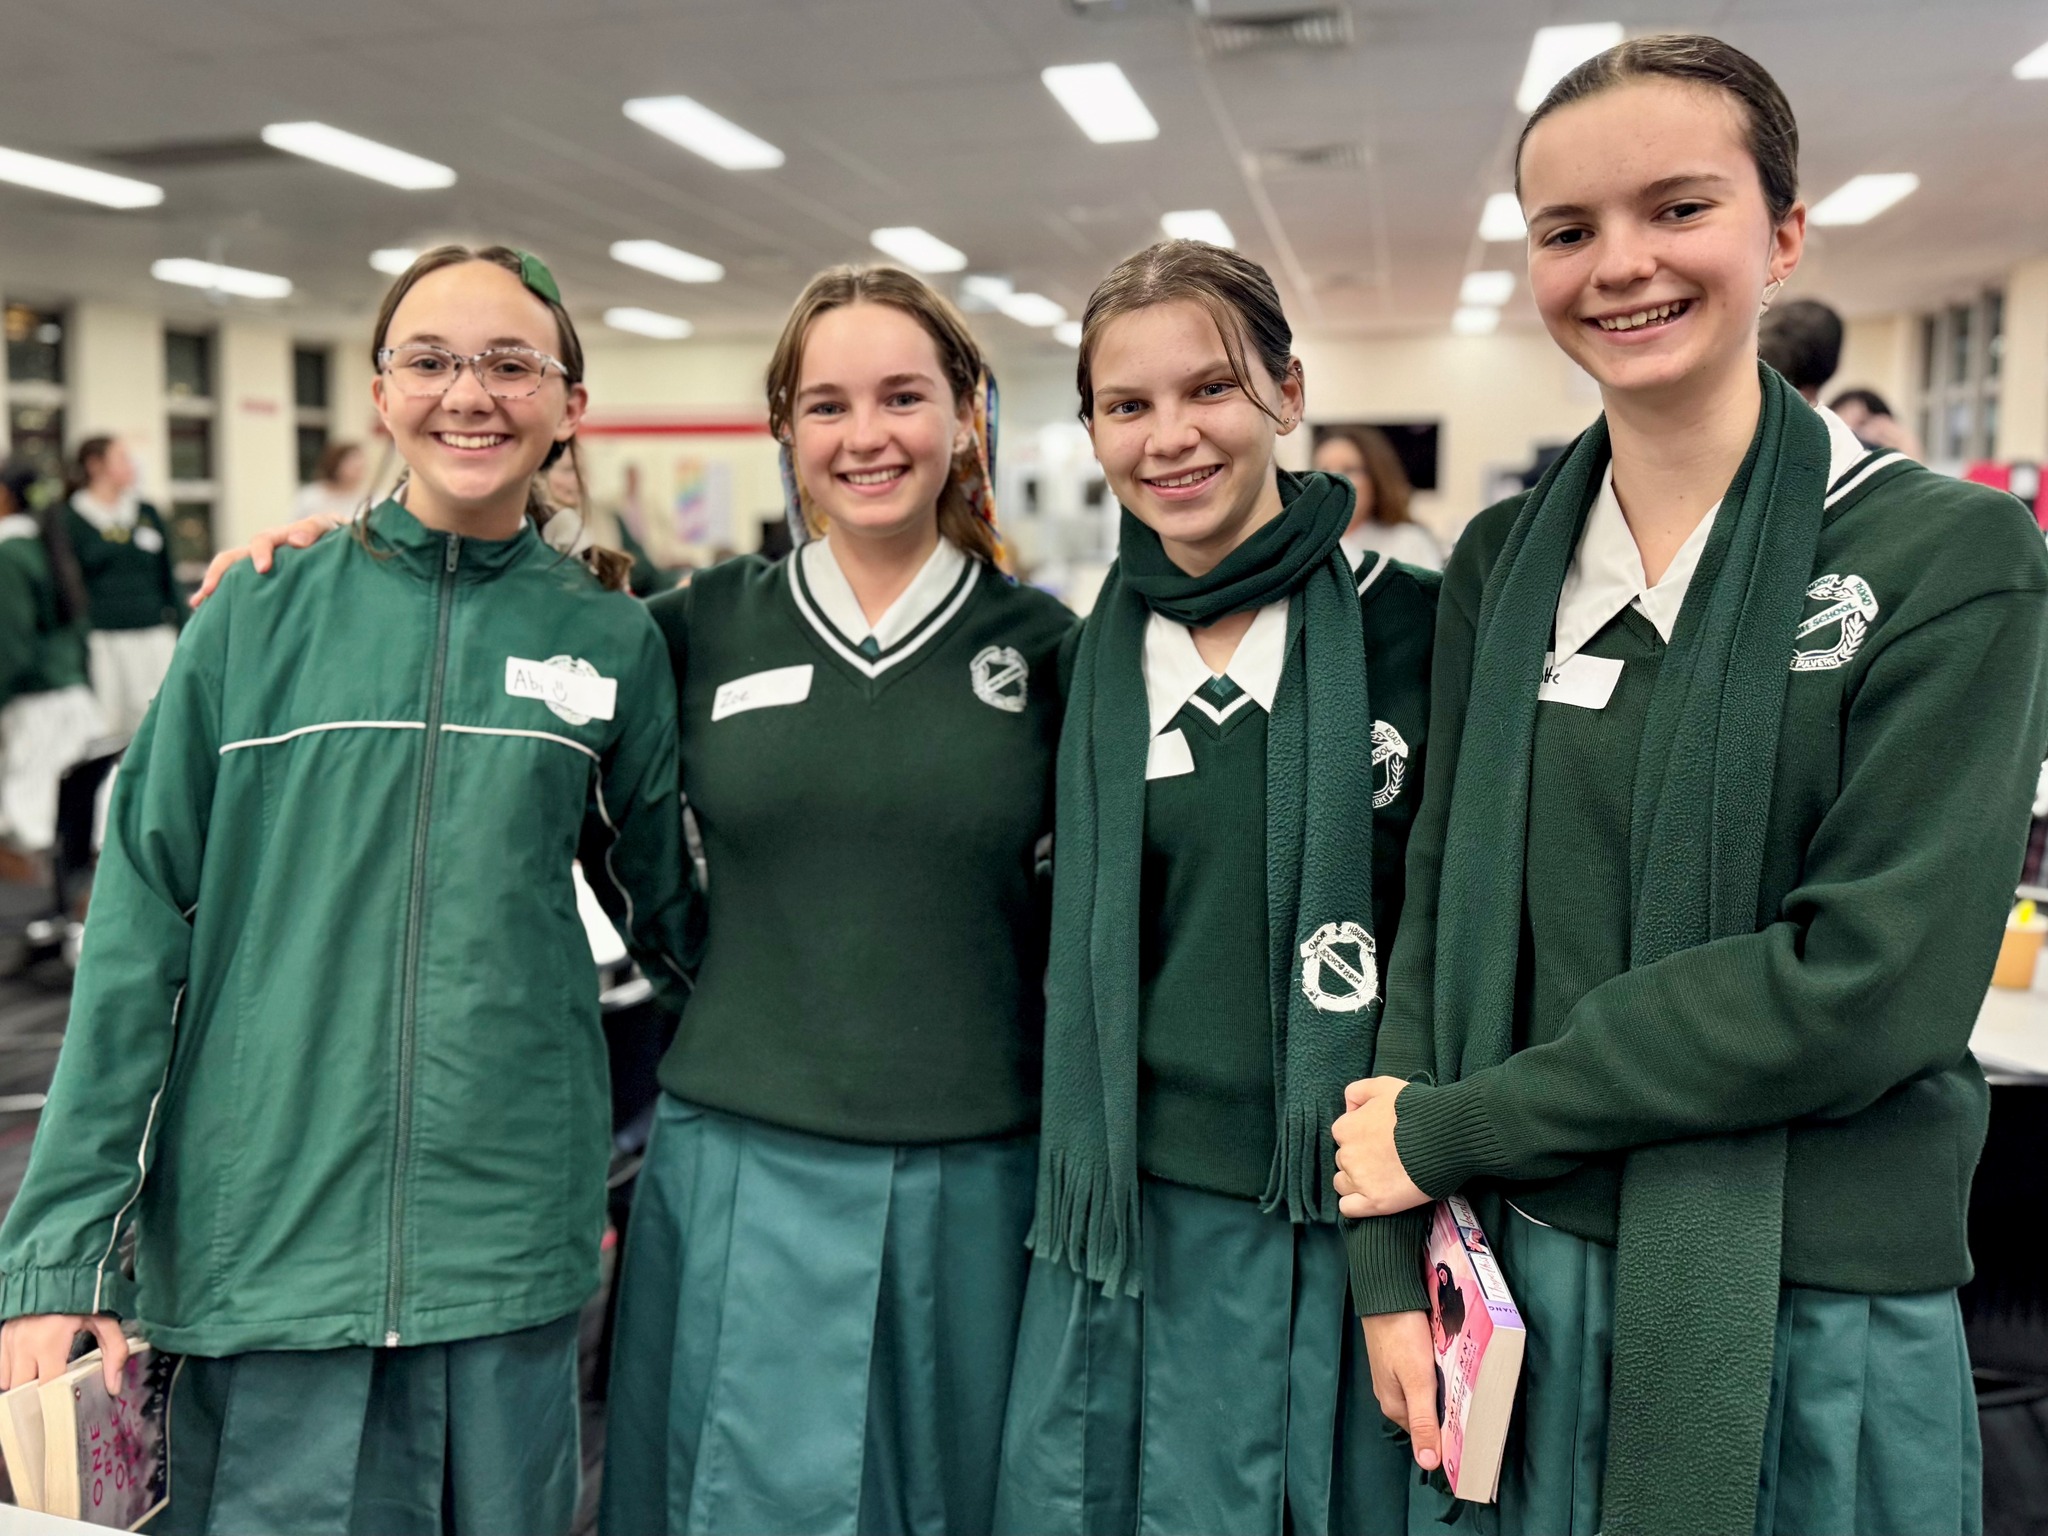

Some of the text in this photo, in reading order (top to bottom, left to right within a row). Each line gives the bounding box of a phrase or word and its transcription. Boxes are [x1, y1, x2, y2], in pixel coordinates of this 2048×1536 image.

[1812, 602, 1857, 626] SCHOOL
[1384, 727, 1401, 746] ROAD
[1488, 1305, 1518, 1315] LIANG
[90, 1421, 103, 1507] ONE
[103, 1440, 112, 1477] BY
